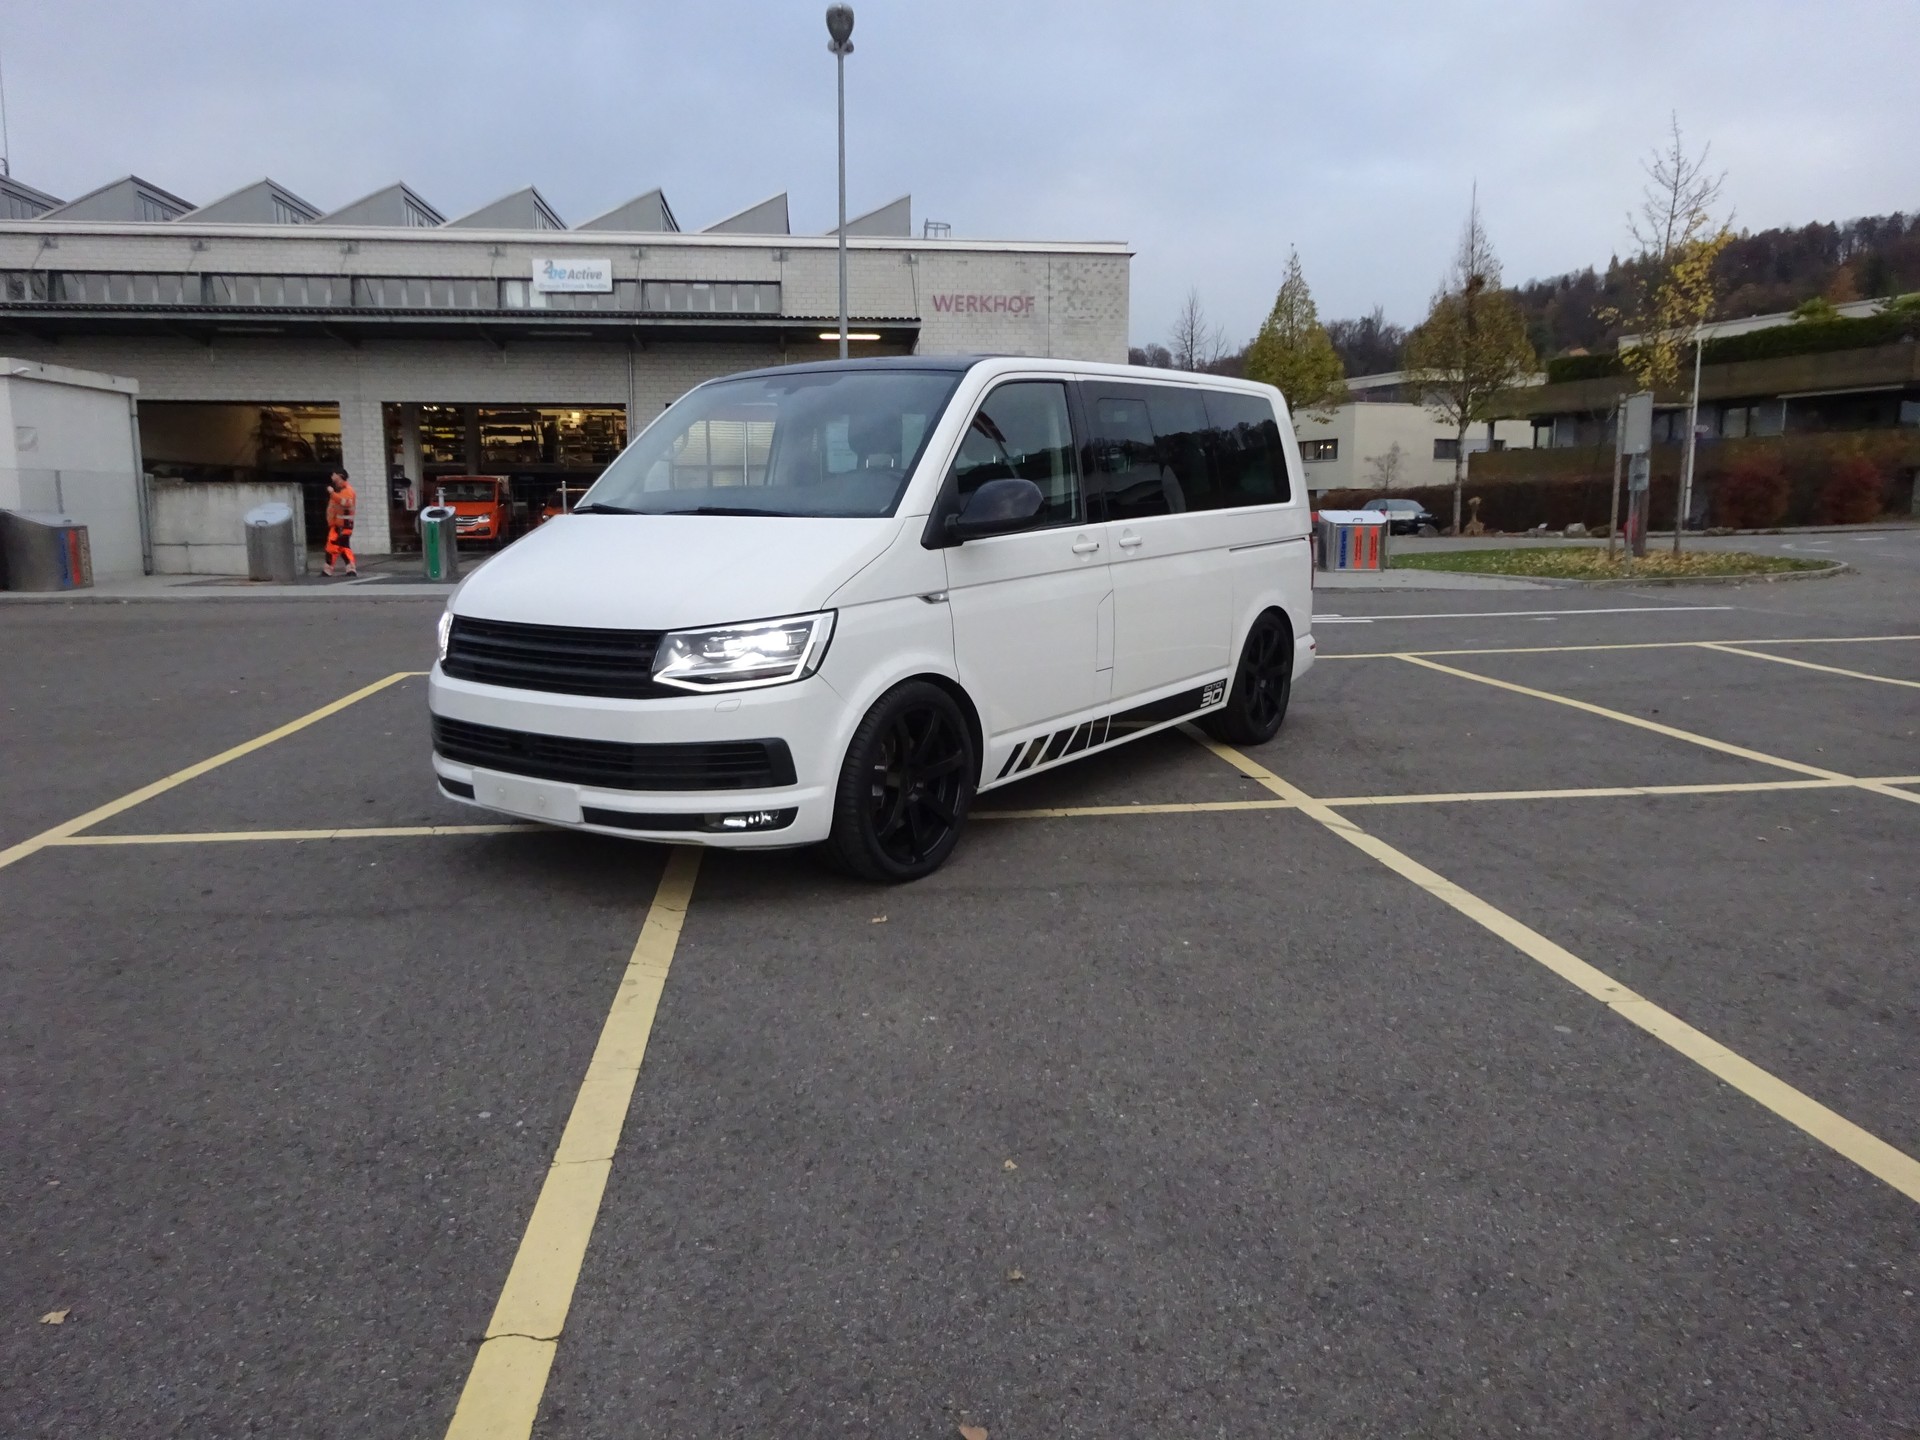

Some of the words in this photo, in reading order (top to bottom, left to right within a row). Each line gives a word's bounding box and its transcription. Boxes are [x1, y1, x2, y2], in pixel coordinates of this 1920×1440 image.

[567, 267, 603, 280] Active
[932, 294, 1036, 313] WERKHOF
[1200, 687, 1223, 708] 30
